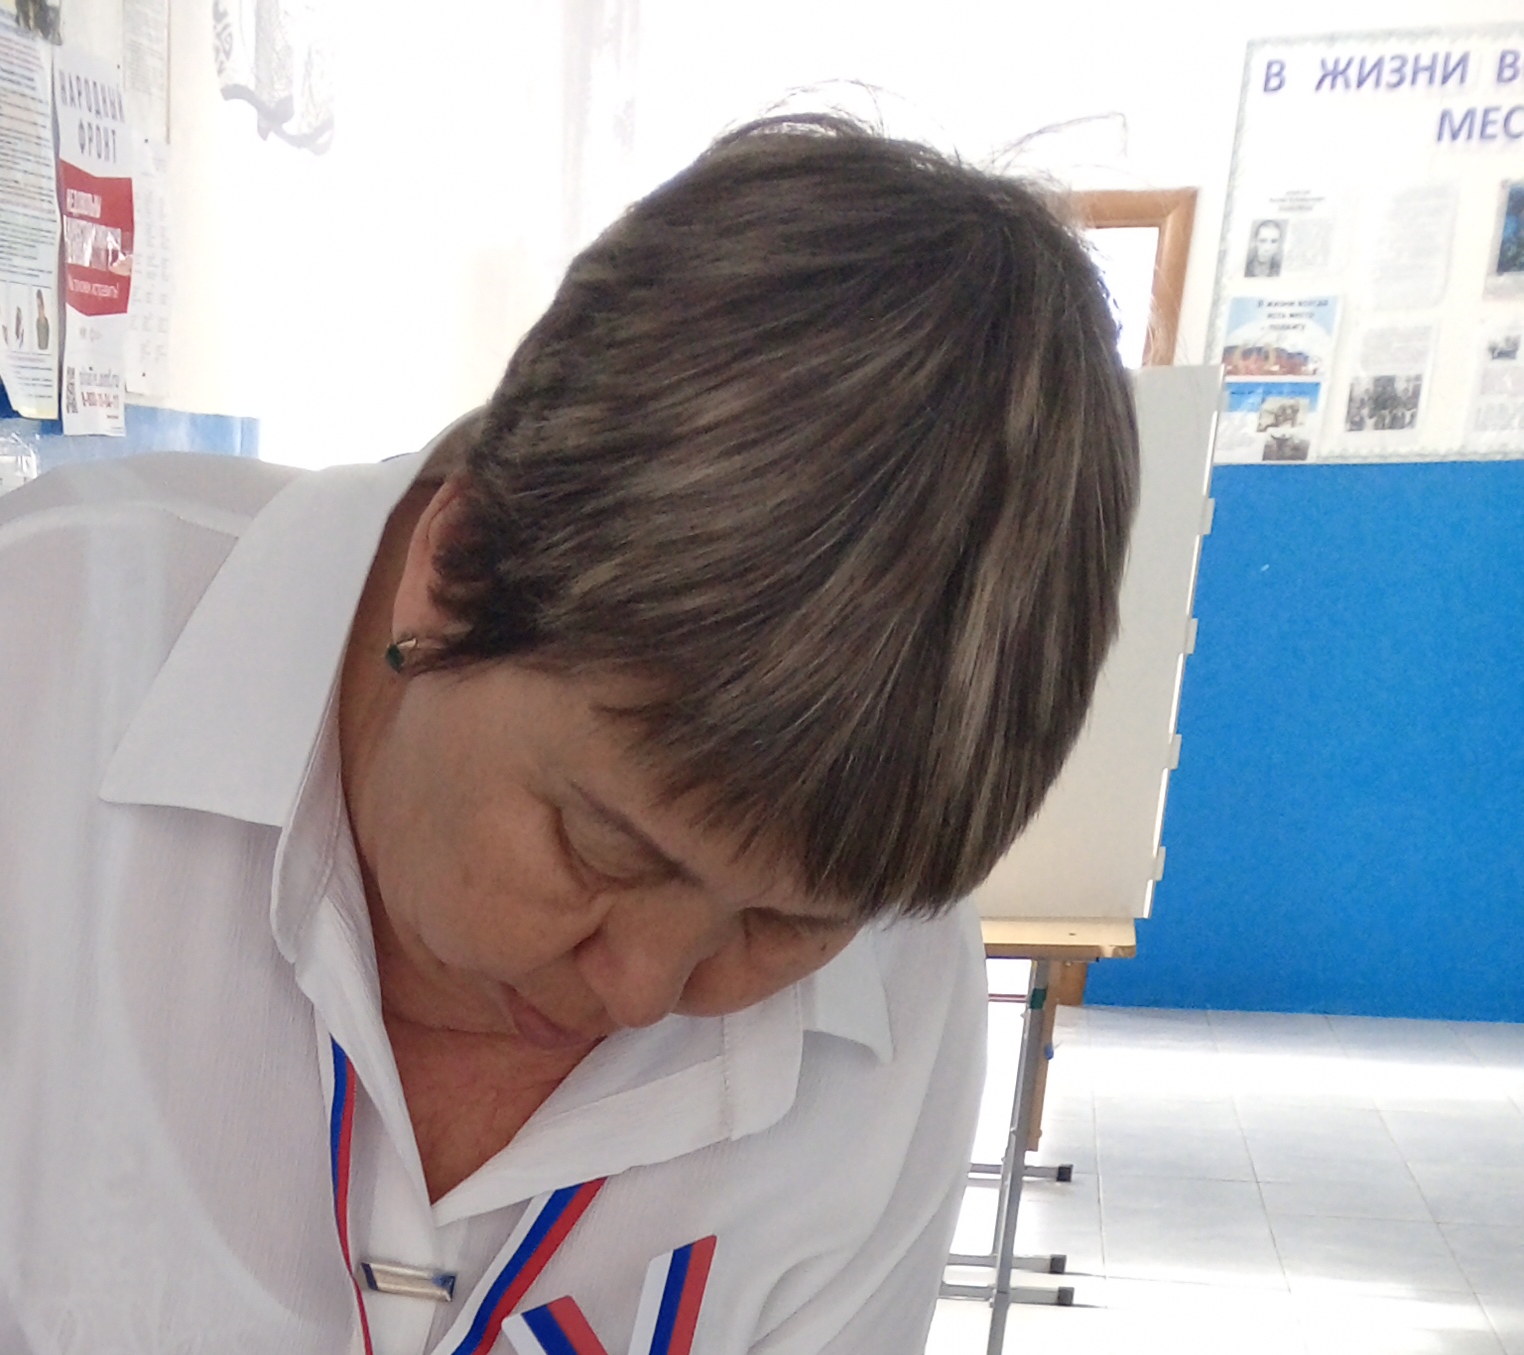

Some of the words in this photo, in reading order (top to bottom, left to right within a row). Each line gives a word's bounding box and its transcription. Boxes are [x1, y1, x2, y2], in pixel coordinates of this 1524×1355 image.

[1263, 59, 1286, 94] В
[1315, 50, 1471, 92] ЖИЗНИ
[77, 117, 117, 164] ФРОНТ
